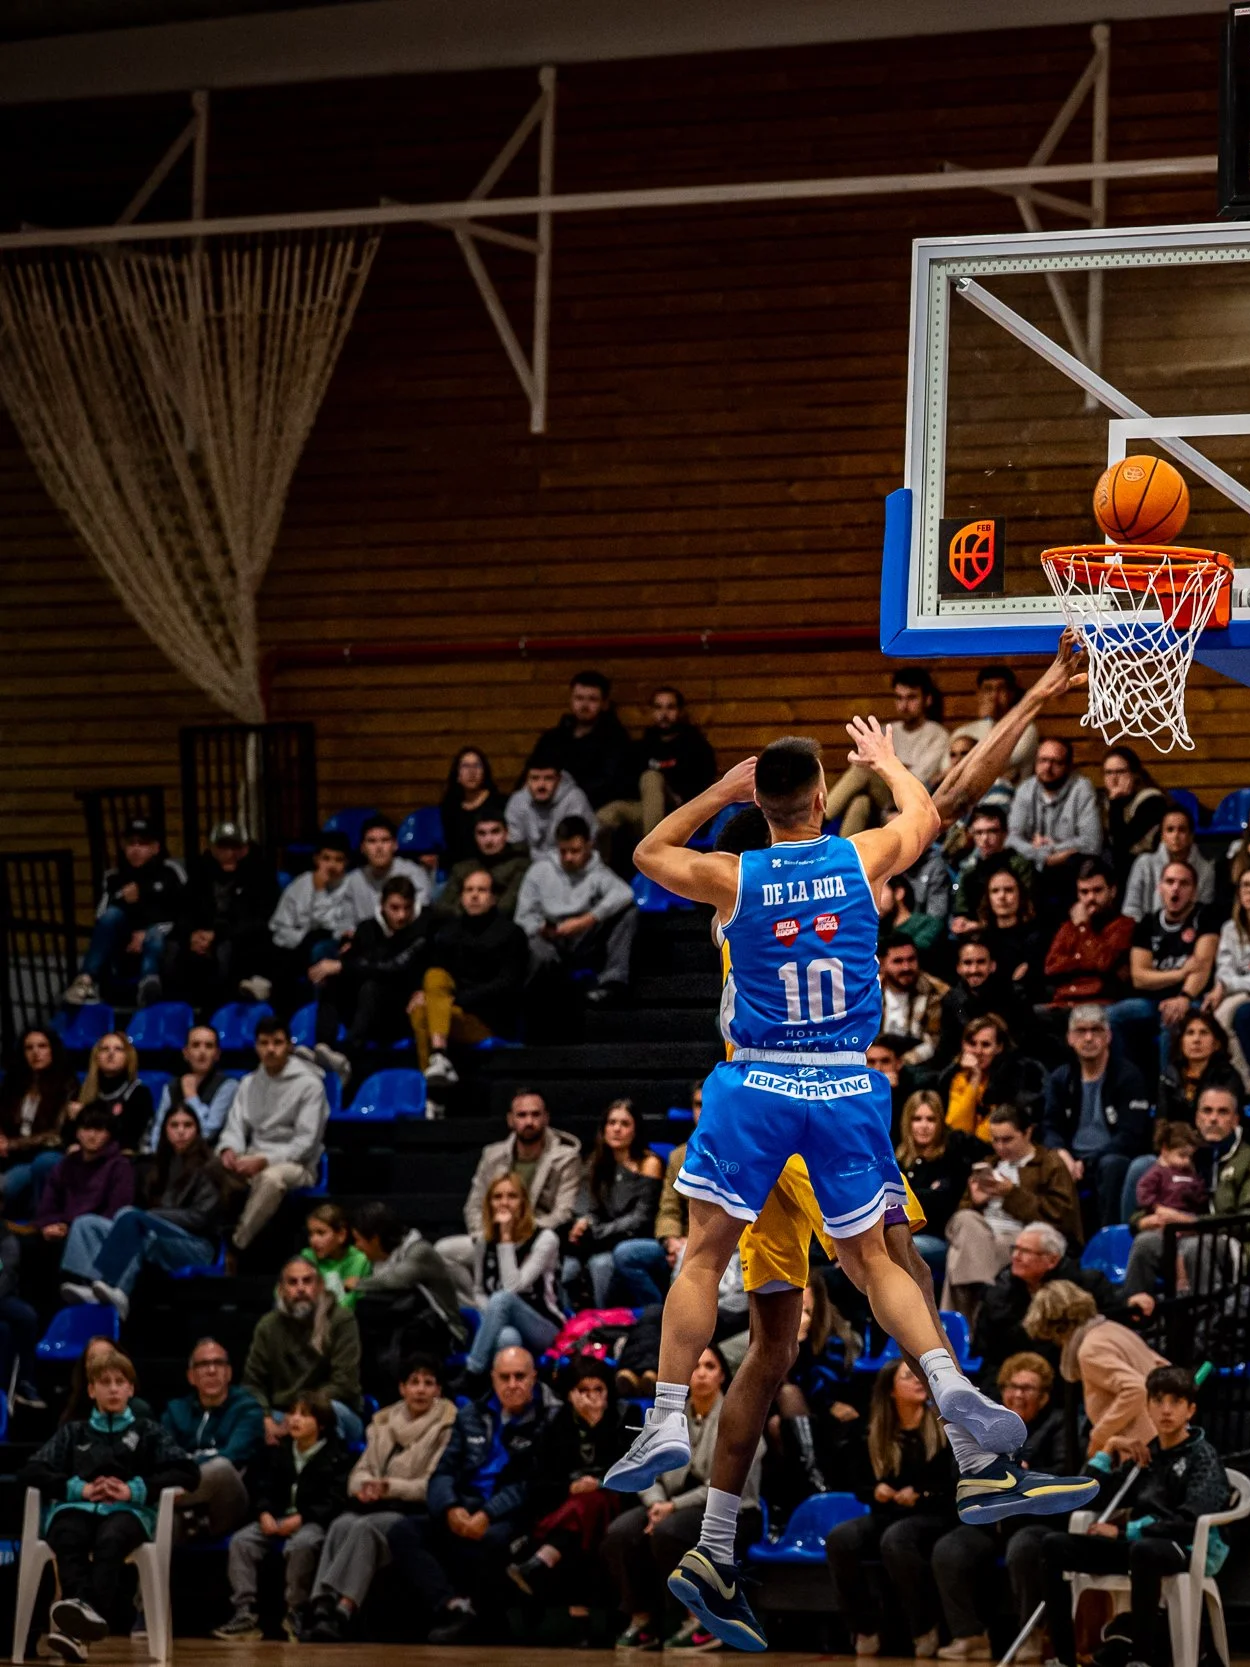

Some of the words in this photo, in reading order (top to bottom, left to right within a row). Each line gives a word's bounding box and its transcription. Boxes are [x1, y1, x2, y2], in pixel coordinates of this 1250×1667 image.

[762, 884, 783, 906] DE
[787, 881, 809, 903] LA
[778, 957, 848, 1025] 10
